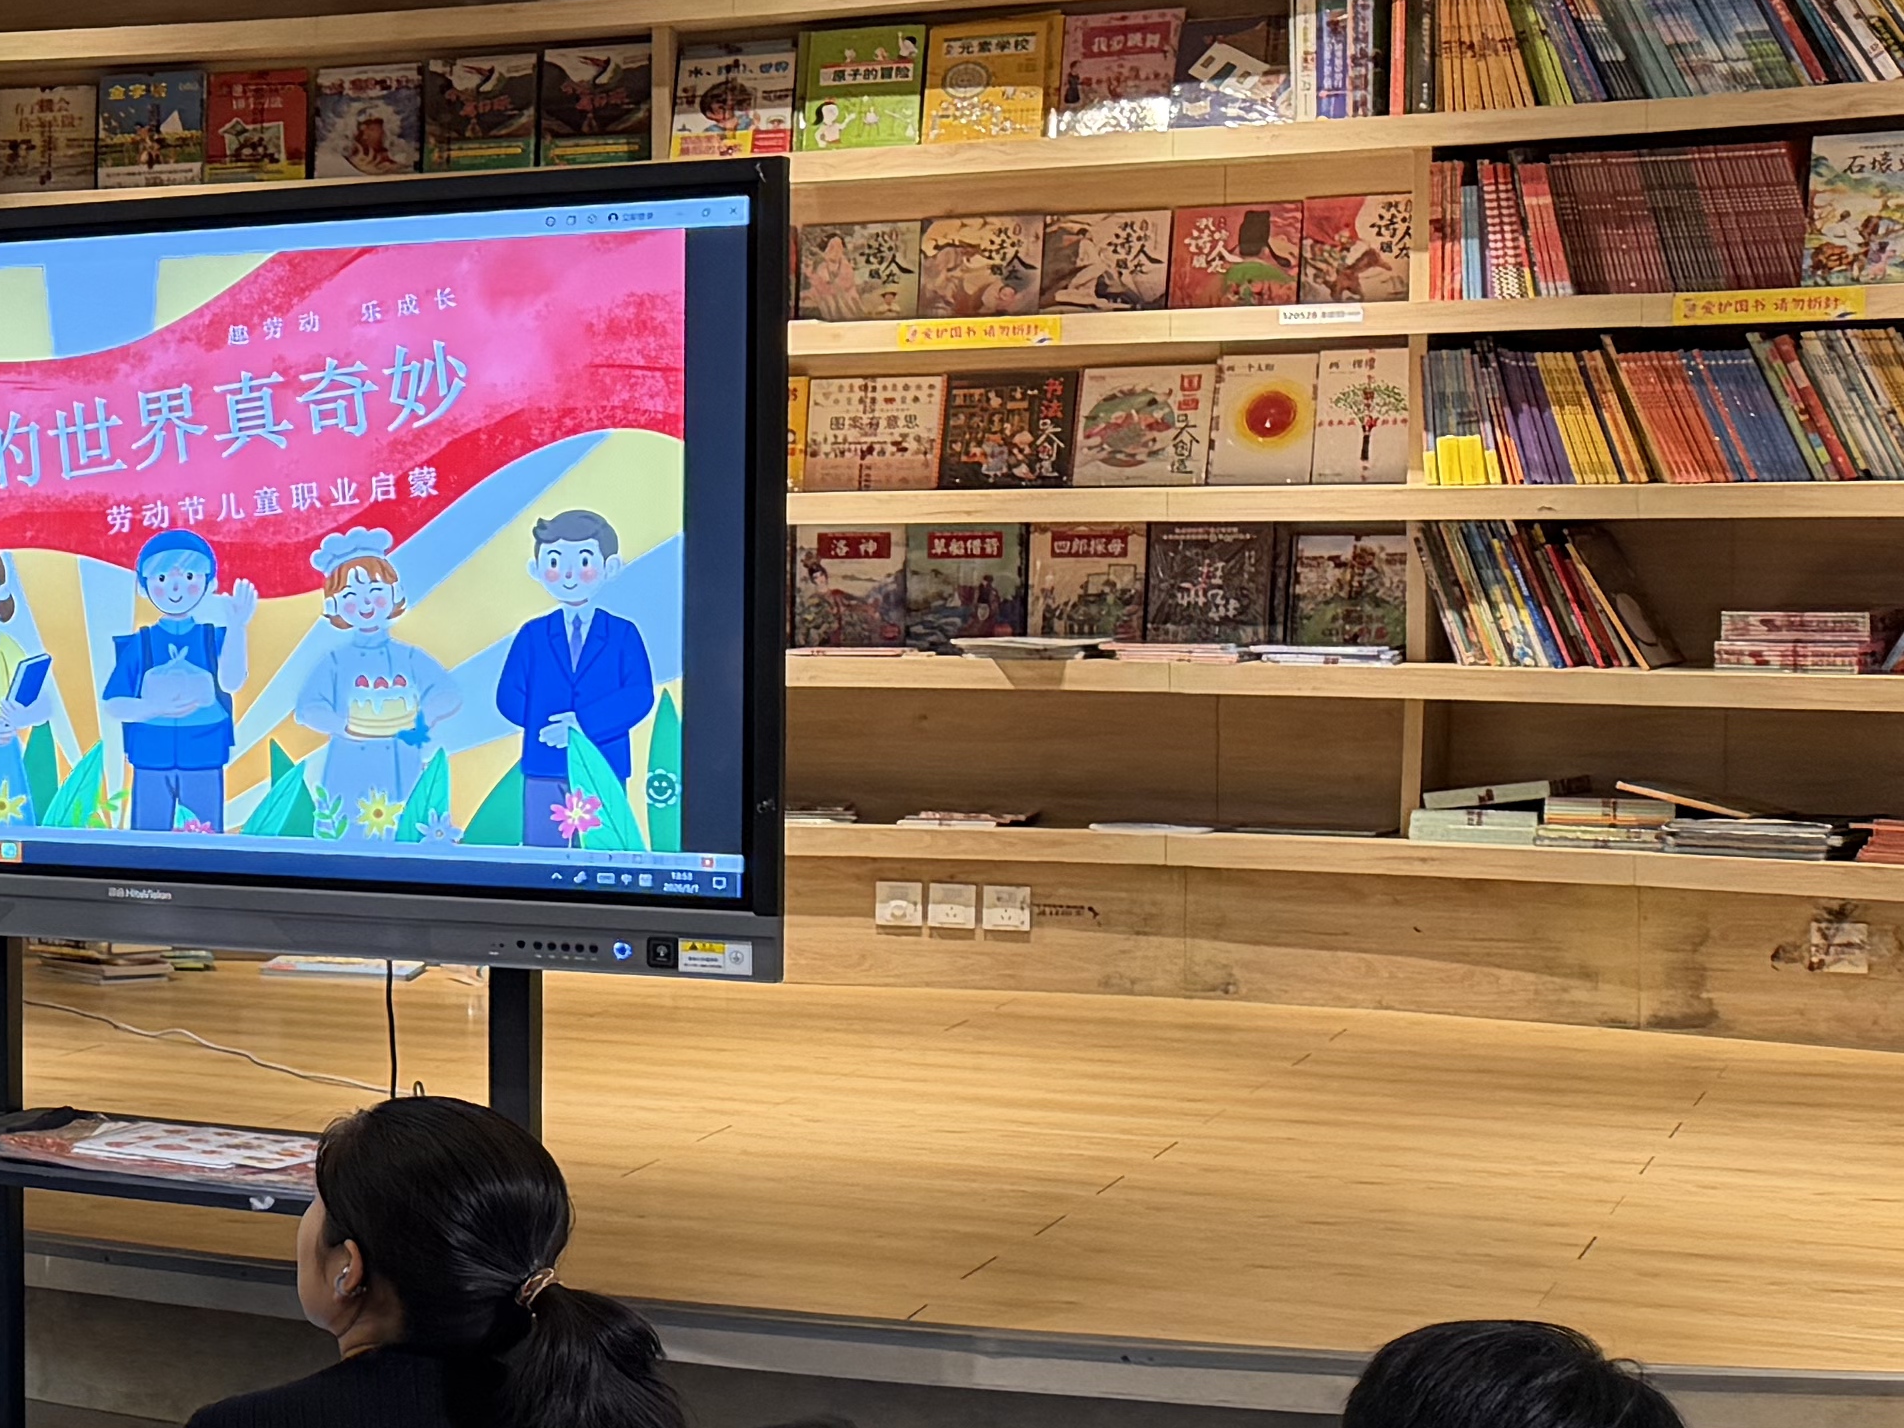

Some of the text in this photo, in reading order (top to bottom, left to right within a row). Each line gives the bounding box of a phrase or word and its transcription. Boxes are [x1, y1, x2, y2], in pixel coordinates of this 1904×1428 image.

[832, 65, 912, 81] 原子的冒险
[227, 284, 461, 348] 趣劳动 乐成长
[1702, 296, 1842, 316] 爱护图书 请勿拆封
[923, 325, 978, 340] 爱护图书
[828, 412, 921, 432] 图案有意思
[104, 463, 441, 537] 劳动节儿童职业启蒙
[830, 538, 878, 558] 洛神
[929, 534, 1001, 558] 草船借箭
[1053, 534, 1126, 557] 四郎探母
